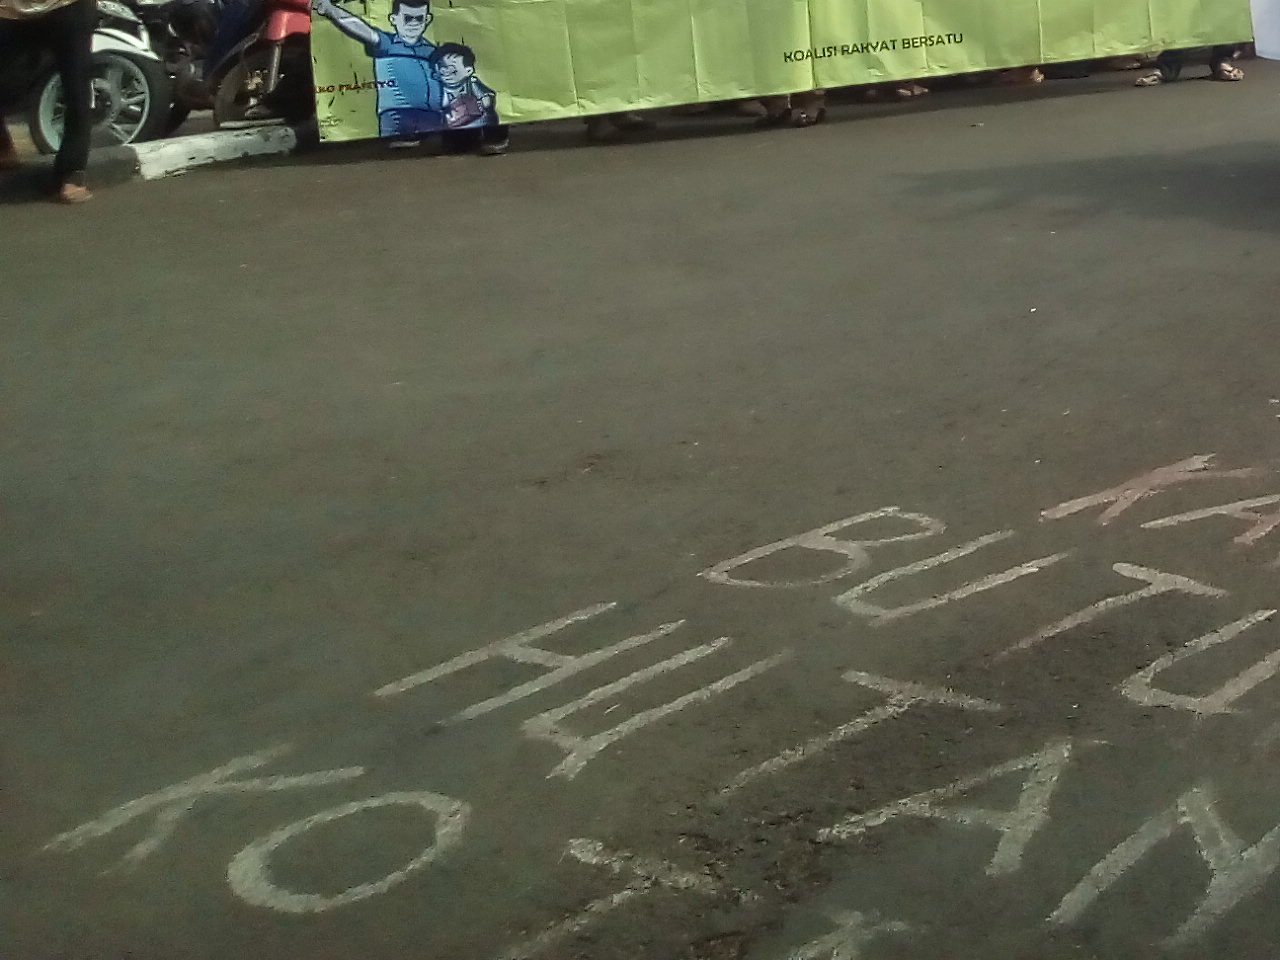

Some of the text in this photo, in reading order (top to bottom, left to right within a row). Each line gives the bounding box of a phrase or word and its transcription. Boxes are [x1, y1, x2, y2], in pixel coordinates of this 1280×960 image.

[783, 33, 964, 63] KOALISI RAKYAT BERSATU
